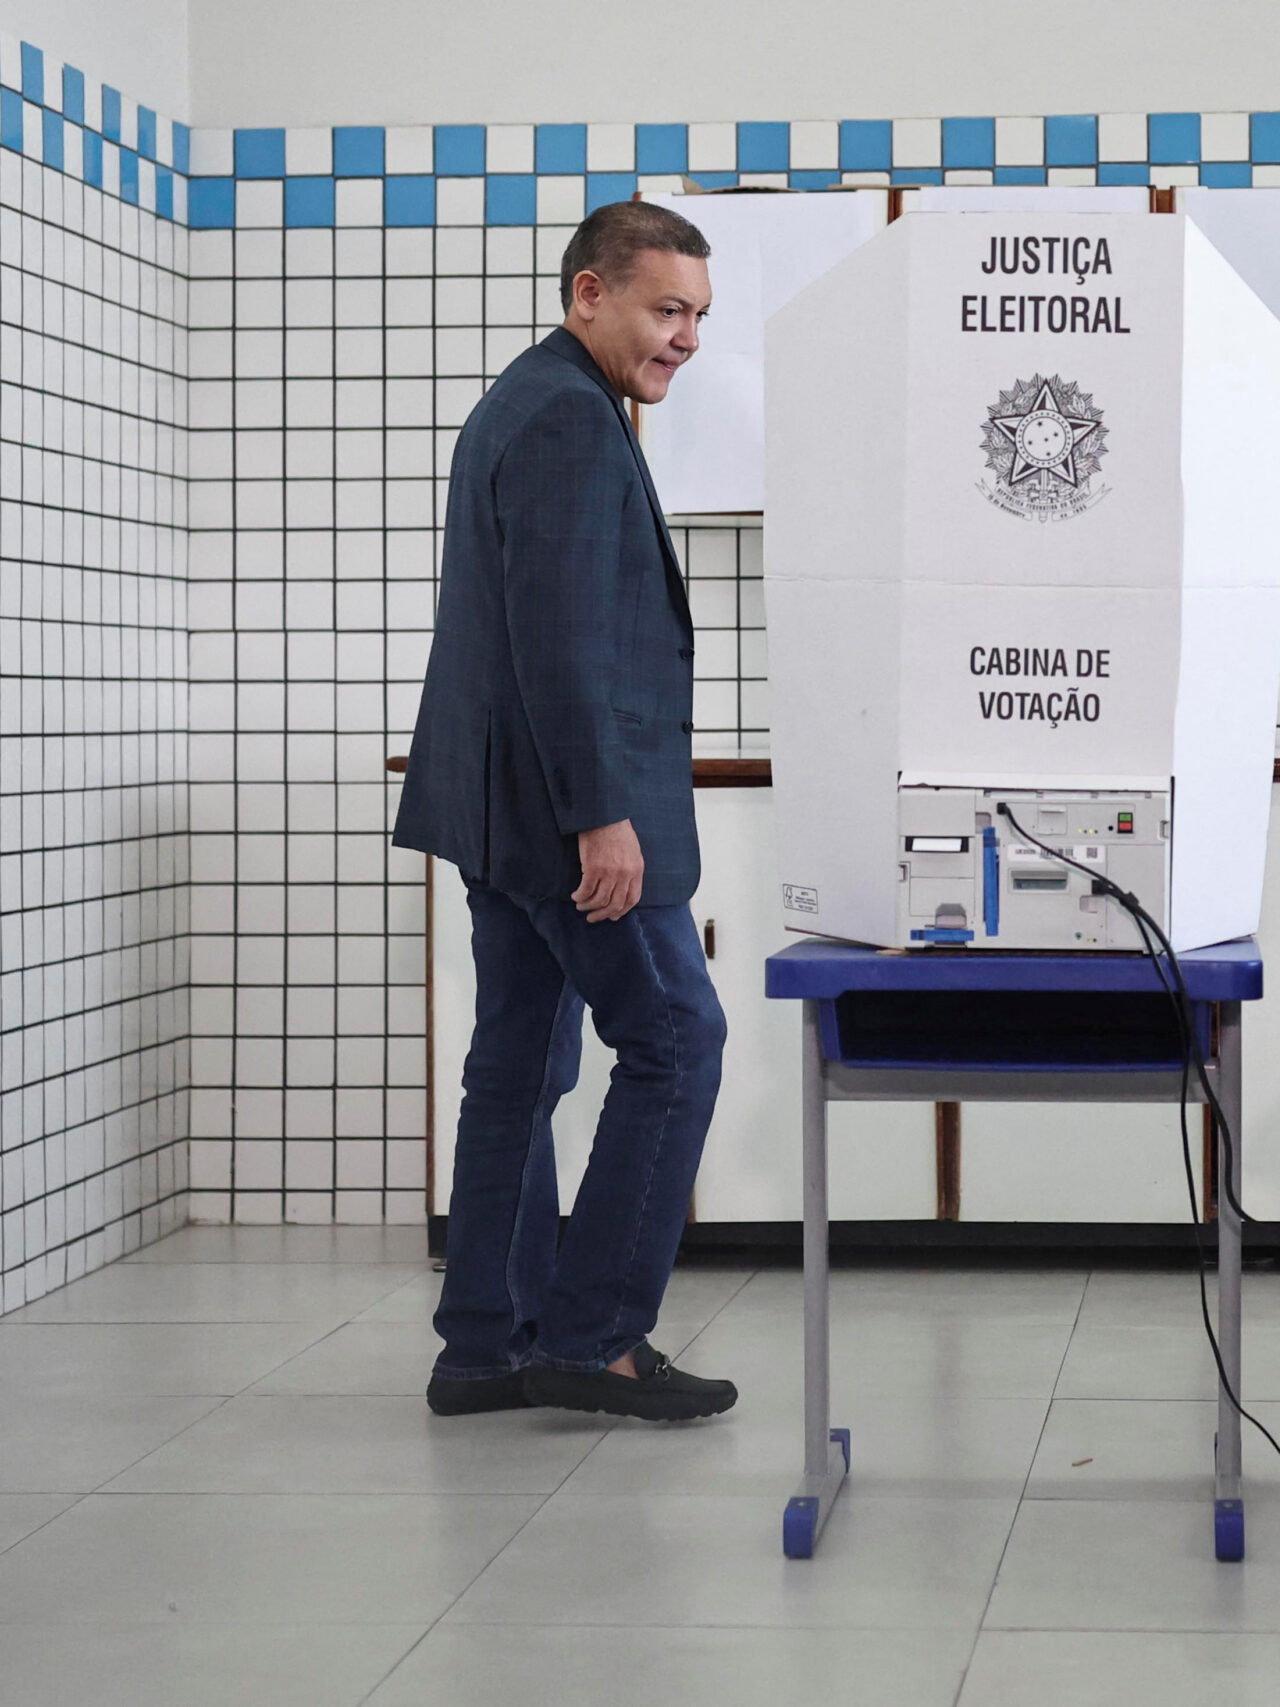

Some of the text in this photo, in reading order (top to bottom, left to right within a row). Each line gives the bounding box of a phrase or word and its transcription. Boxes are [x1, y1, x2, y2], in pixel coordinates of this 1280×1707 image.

[981, 236, 1112, 285] JUSTIÇA
[961, 295, 1131, 334] ELEITORAL
[969, 646, 1111, 678] CABINA DE
[978, 687, 1101, 729] VOTAÇÃO
